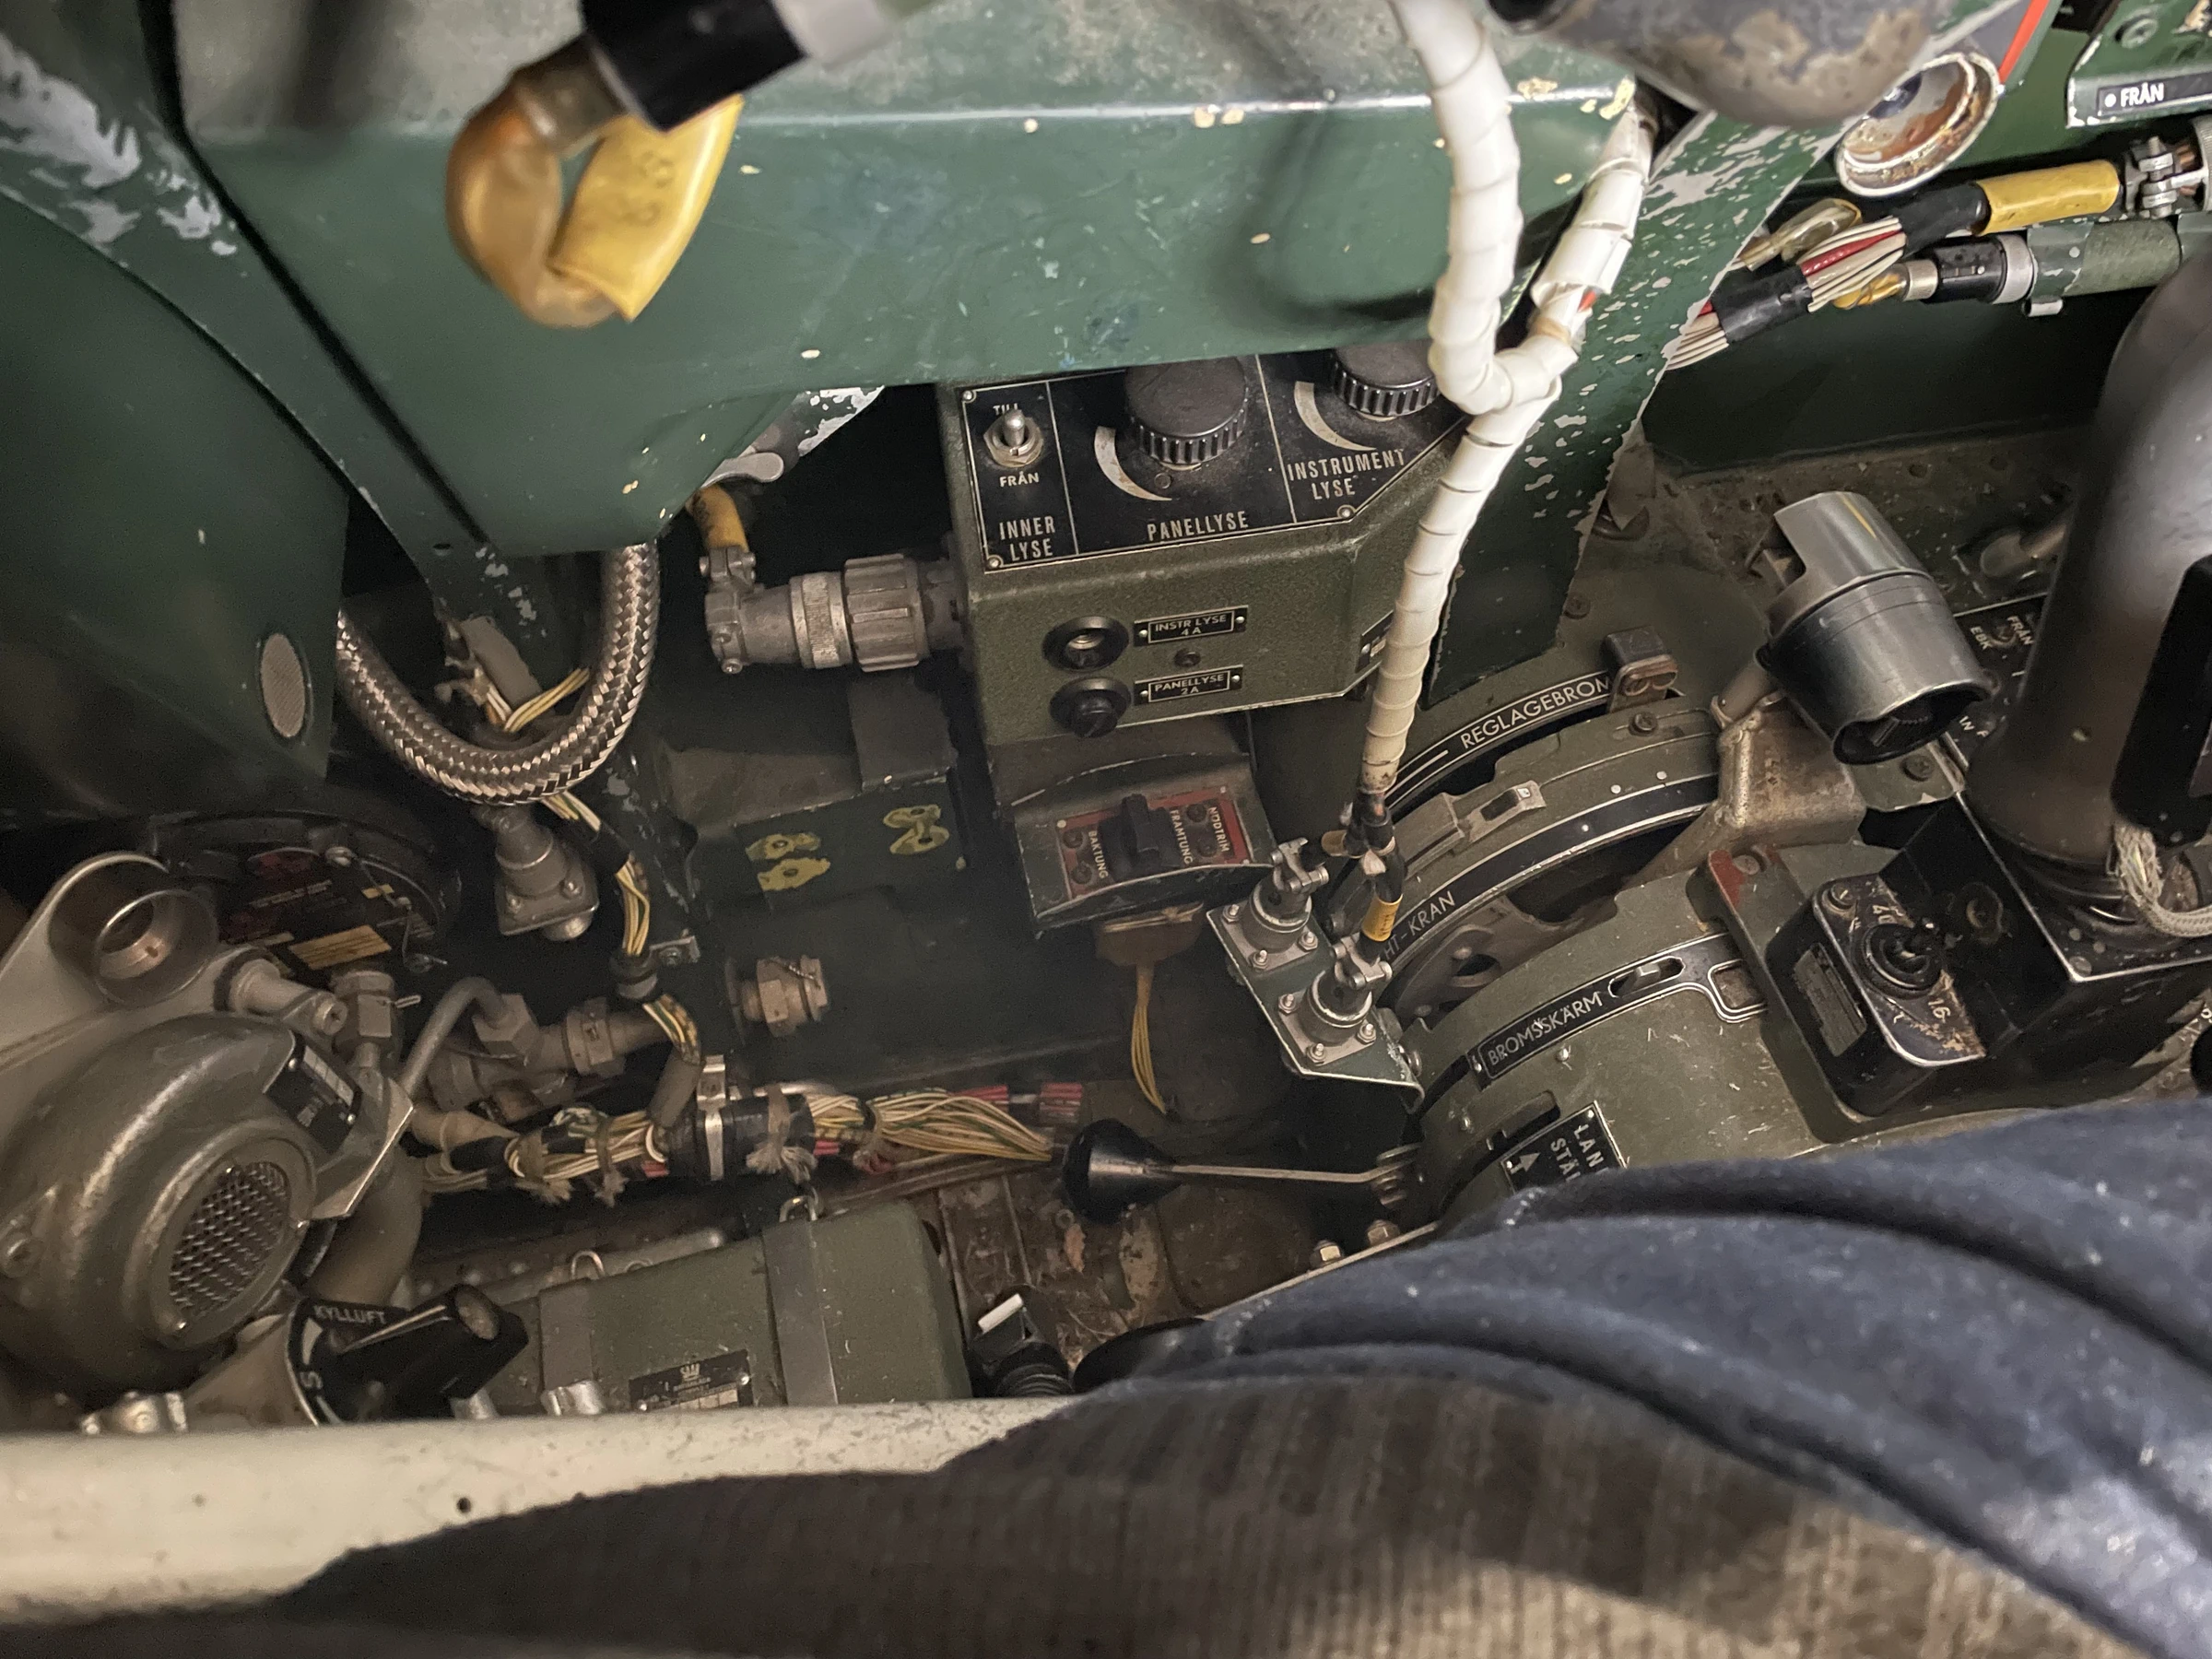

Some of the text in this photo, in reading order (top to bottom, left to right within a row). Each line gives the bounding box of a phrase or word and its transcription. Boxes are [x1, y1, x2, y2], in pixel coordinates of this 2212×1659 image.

[2121, 82, 2164, 107] FRÅN
[1287, 448, 1405, 481] INSTRUMENT
[999, 471, 1040, 488] FRÅN
[1312, 477, 1355, 500] LYSE
[999, 515, 1055, 540] INNER
[1147, 511, 1249, 541] PANELLYSE
[1010, 538, 1053, 561] LYSE
[1155, 614, 1227, 632] INSTR LYSE
[1155, 674, 1224, 691] PANELLYSE
[1169, 809, 1194, 865] FRAMTUNG
[1088, 830, 1109, 878] BAKTUNG
[1488, 991, 1603, 1065] BROMSSKÄRM
[1574, 1124, 1608, 1174] LAN
